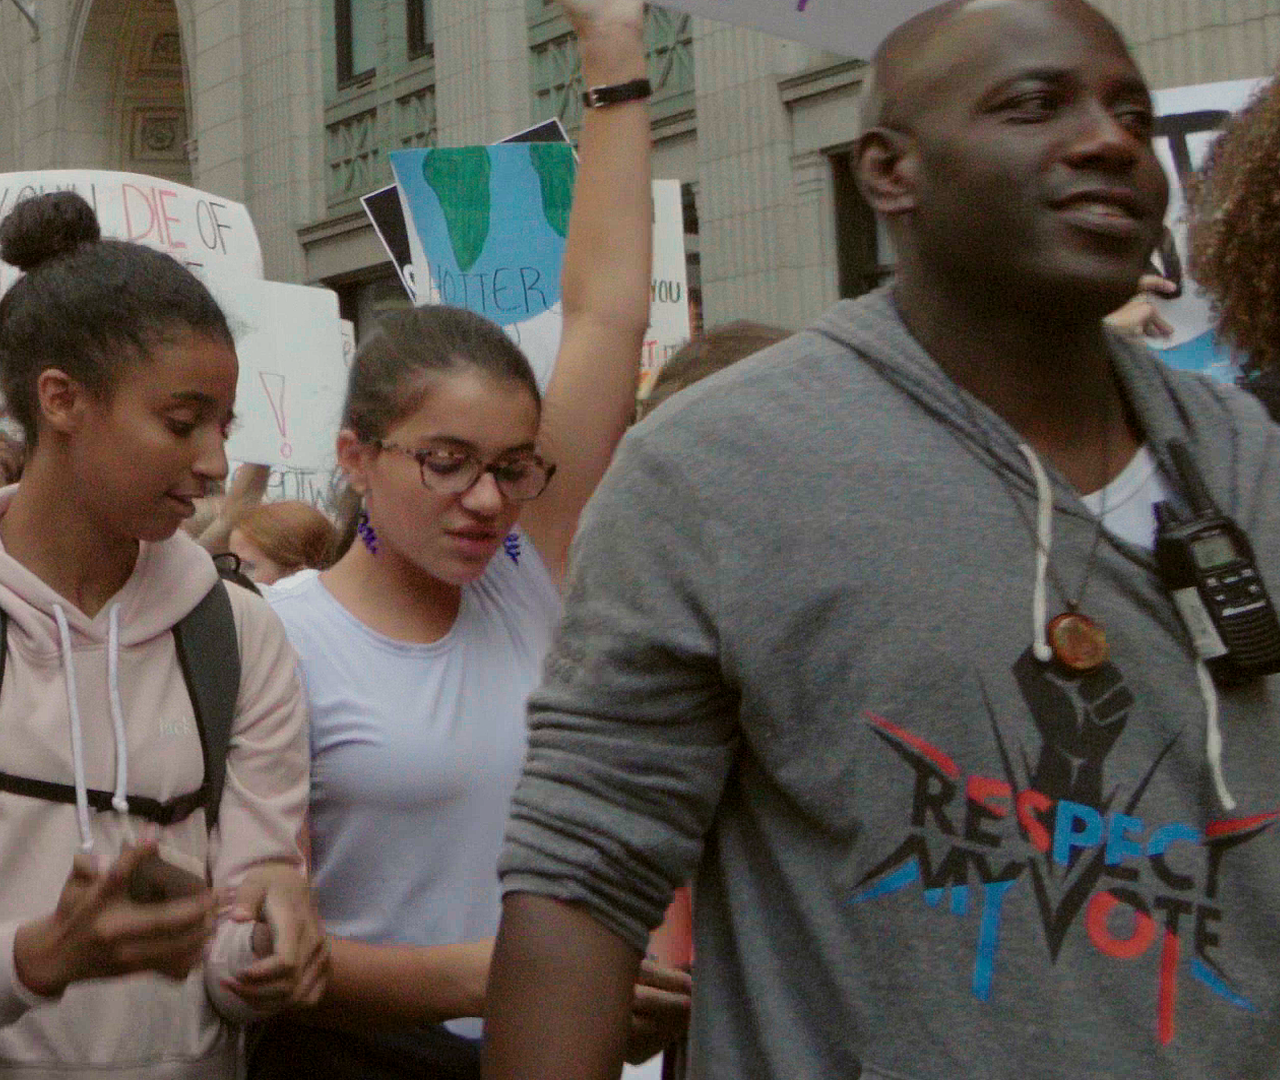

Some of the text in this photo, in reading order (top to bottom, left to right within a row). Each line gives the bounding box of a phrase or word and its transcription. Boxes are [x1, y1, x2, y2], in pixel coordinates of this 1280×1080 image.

[122, 183, 188, 249] DIE
[196, 198, 232, 255] OF
[862, 710, 1280, 898] RESPECT
[844, 834, 1030, 1002] MY
